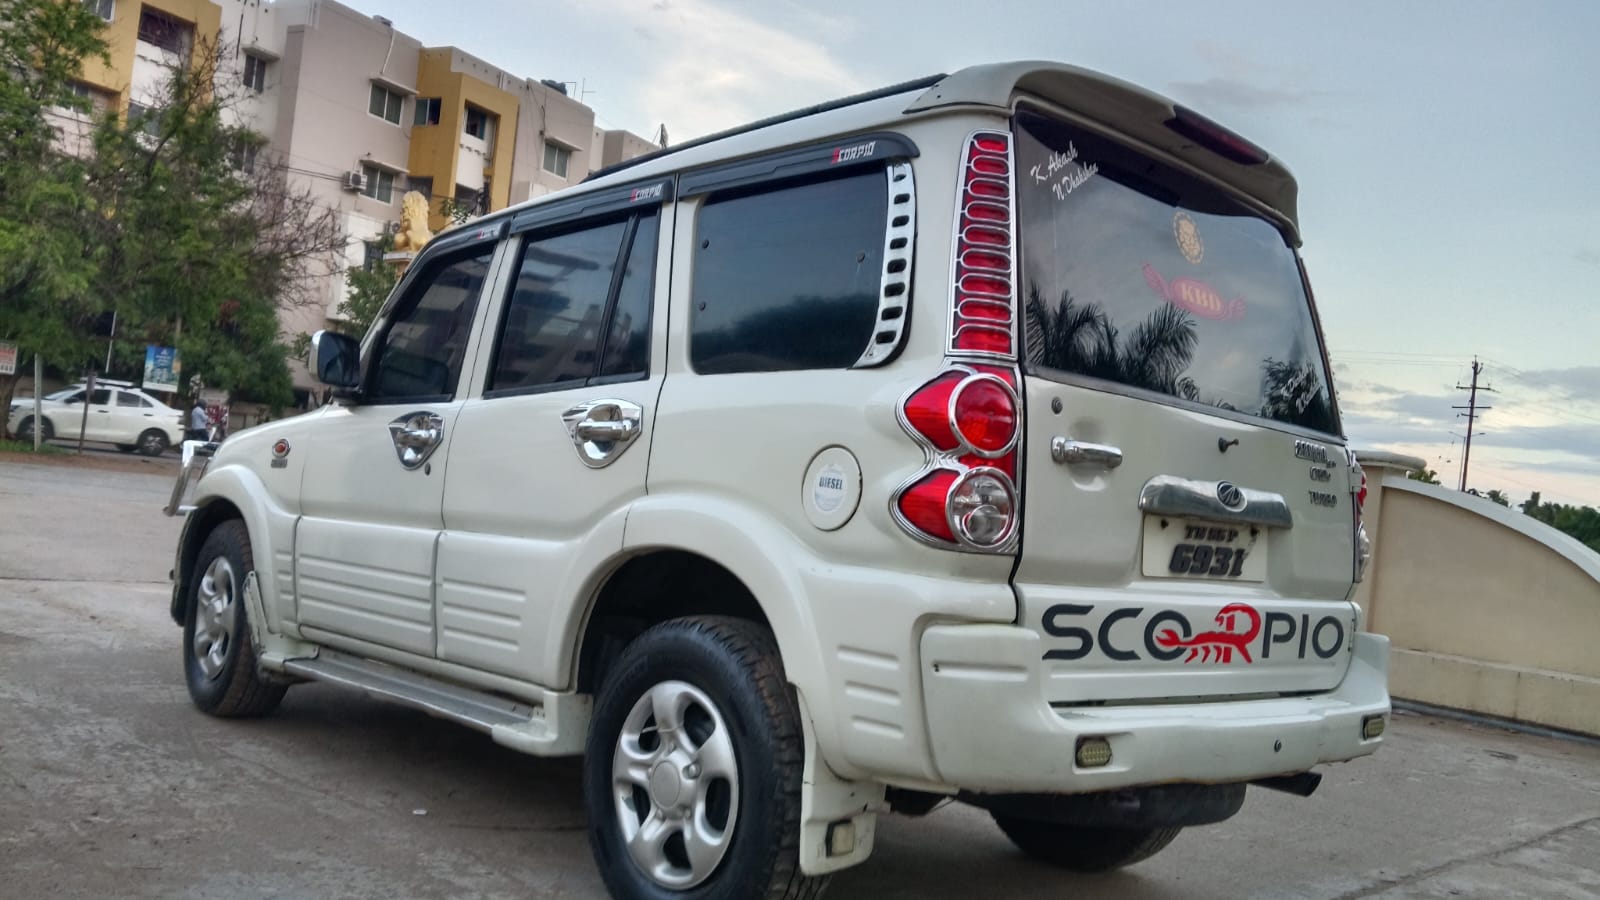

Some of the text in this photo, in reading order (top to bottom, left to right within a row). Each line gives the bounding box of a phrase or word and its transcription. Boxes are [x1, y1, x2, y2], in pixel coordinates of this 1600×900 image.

[831, 141, 876, 165] SCORPIO
[819, 476, 843, 490] DIESEL
[1169, 544, 1246, 576] 6931
[1042, 603, 1344, 663] SCORPIO
